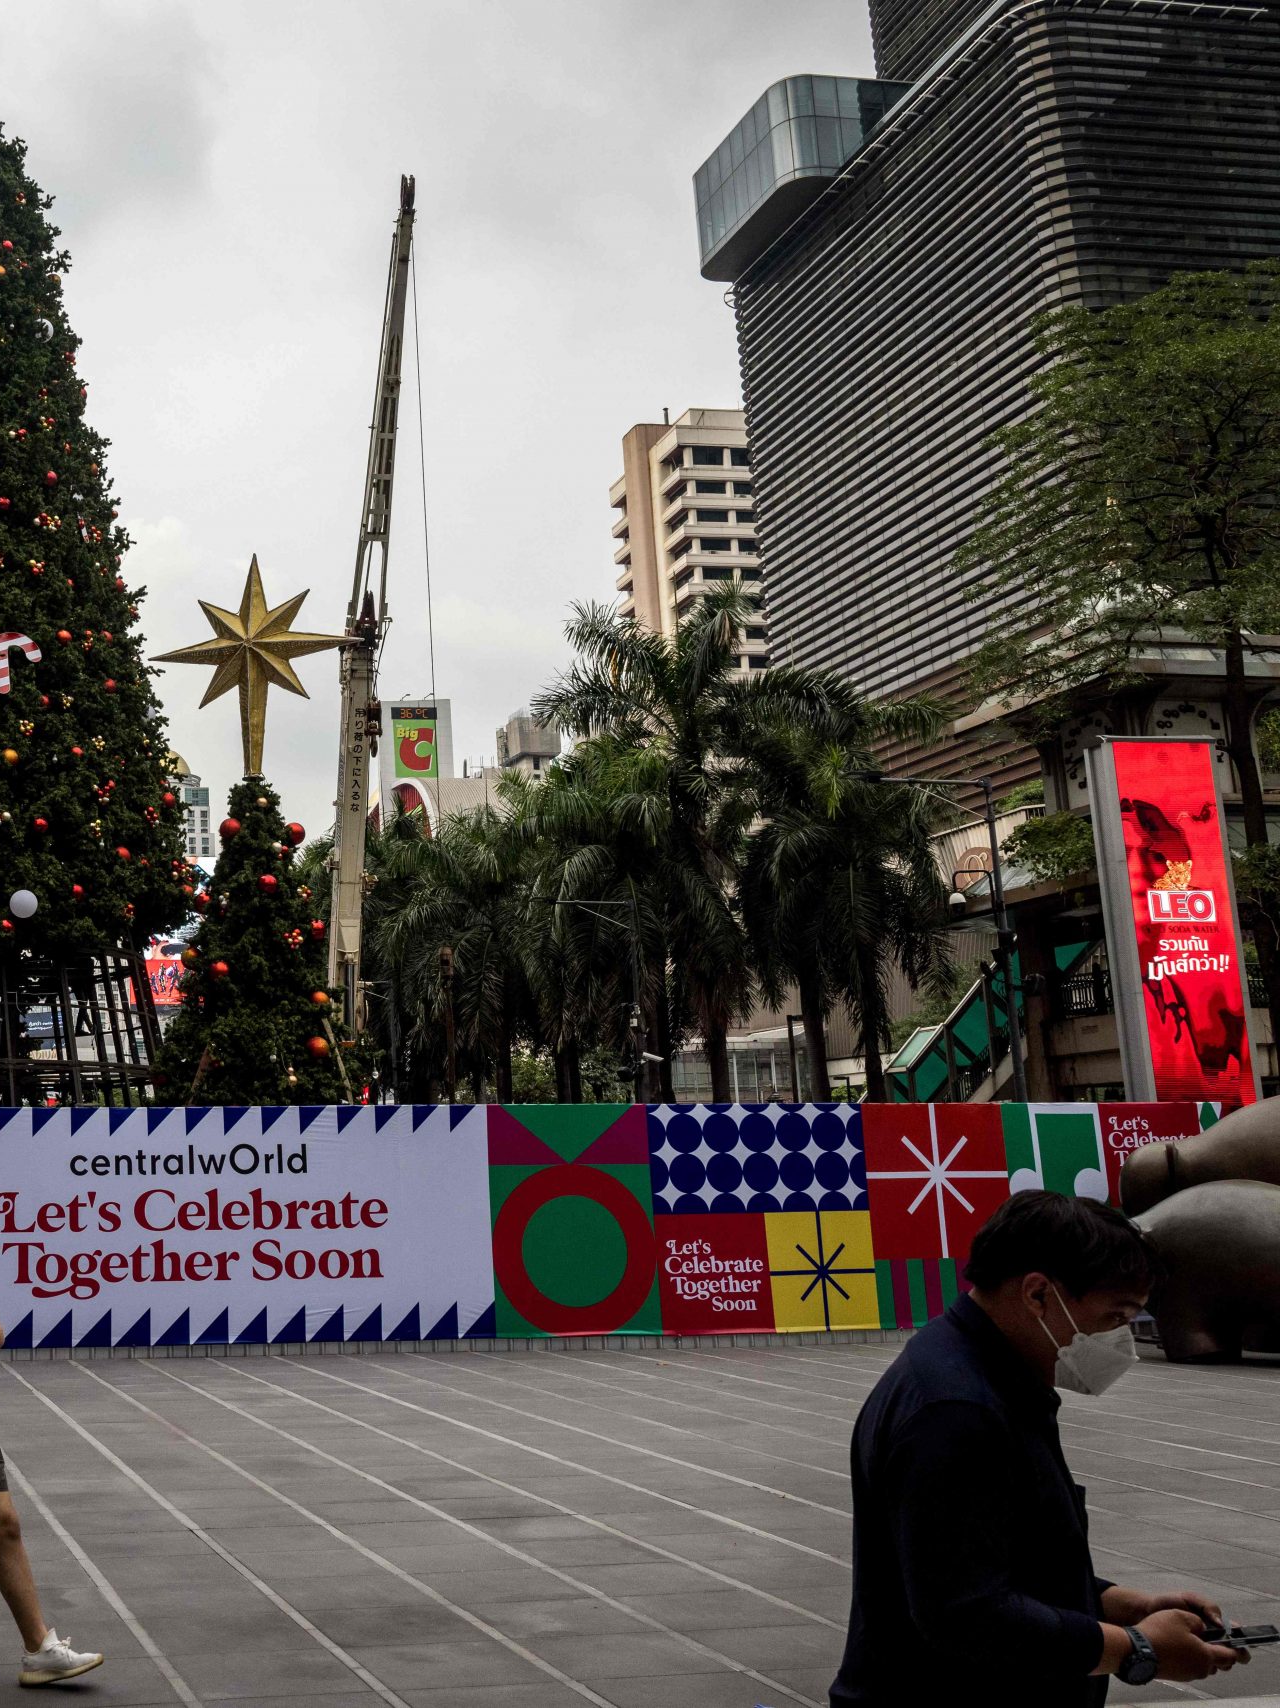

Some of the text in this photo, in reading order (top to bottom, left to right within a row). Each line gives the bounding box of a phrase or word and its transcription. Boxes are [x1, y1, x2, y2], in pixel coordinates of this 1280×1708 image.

[400, 709, 413, 718] 36
[350, 708, 367, 812] 吊り荷の下に入るな
[396, 728, 435, 772] Big C
[1150, 892, 1213, 921] LEO
[1159, 935, 1209, 951] รวมกัน
[1108, 1116, 1149, 1131] Let's
[1108, 1131, 1193, 1148] Celebt
[69, 1143, 309, 1176] centralwOrld
[132, 1187, 389, 1232] Celebrate
[665, 1239, 712, 1255] Let's
[1, 1239, 384, 1300] Together Soon
[664, 1255, 764, 1275] Celebrate
[670, 1275, 762, 1300] Together
[711, 1296, 758, 1312] Soon
